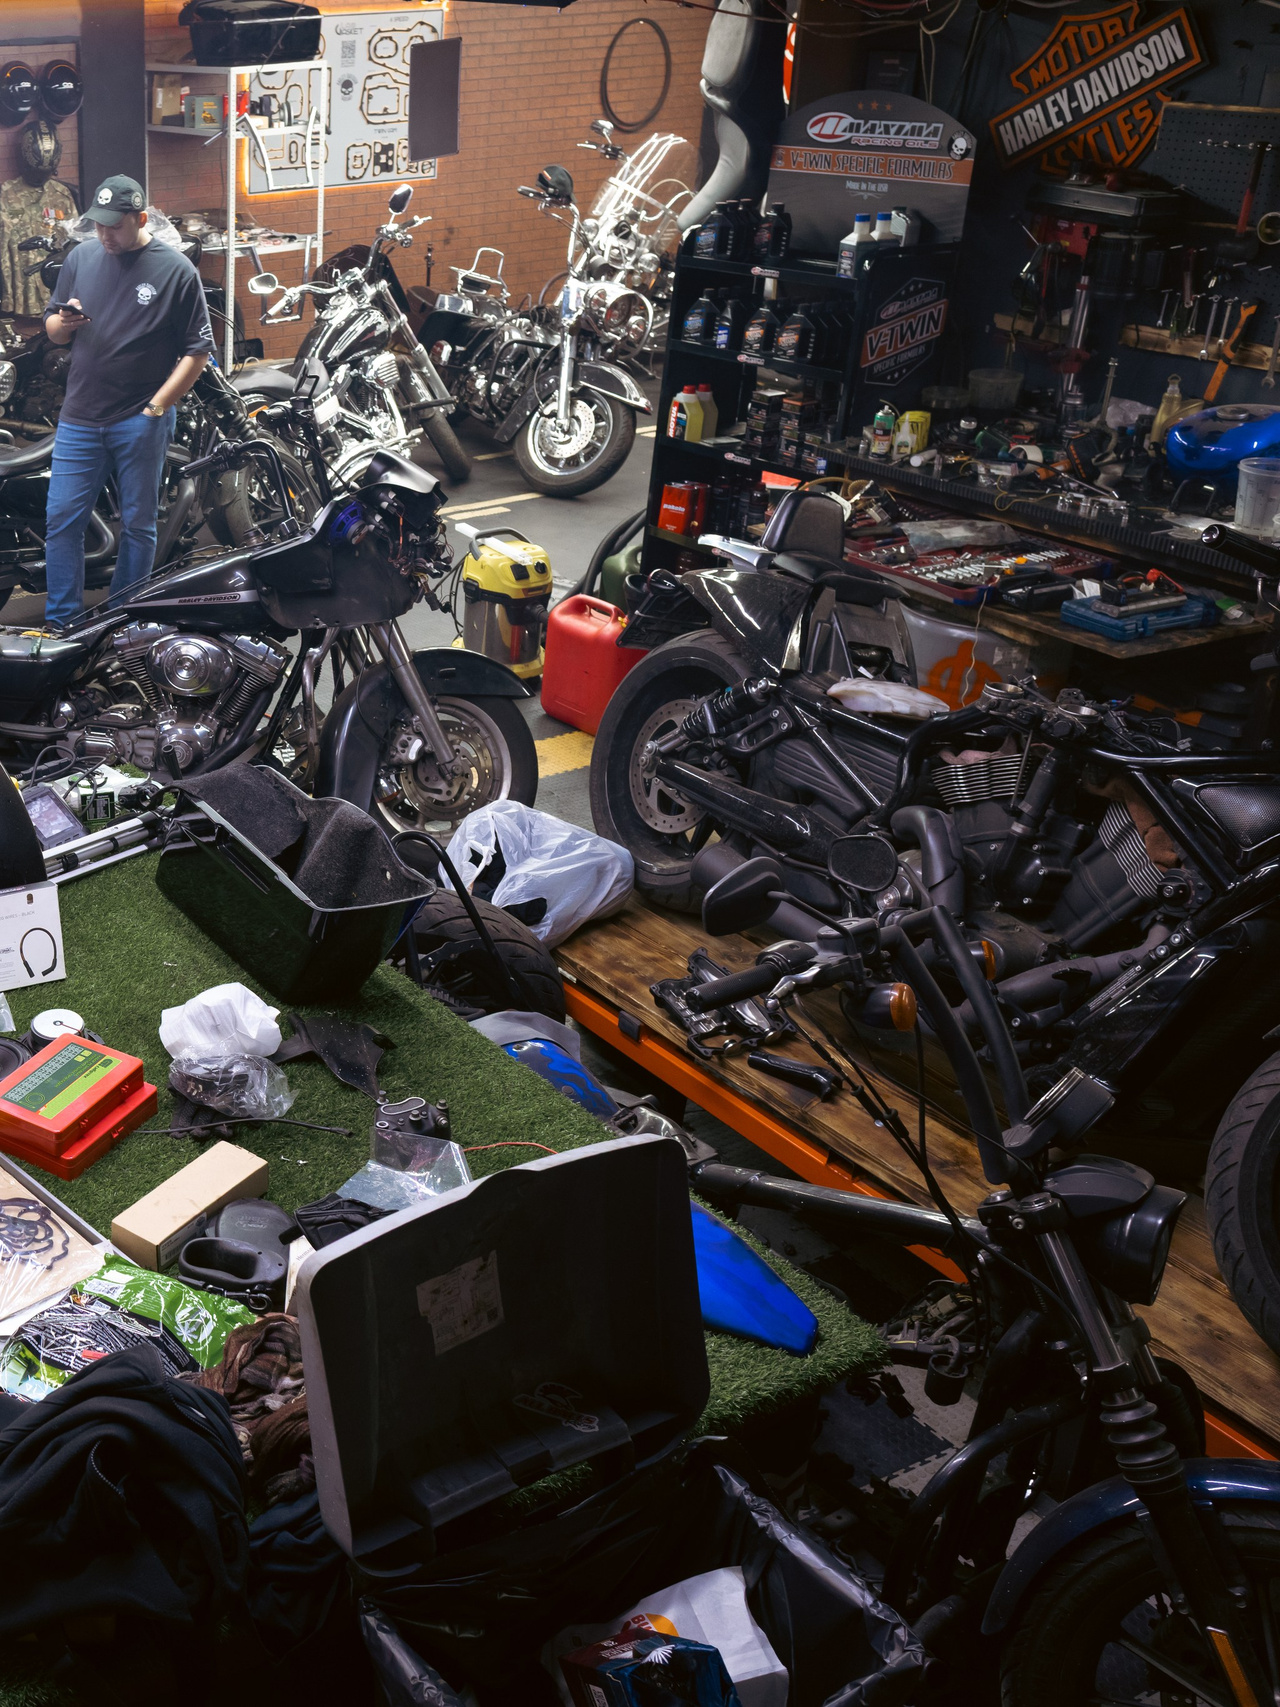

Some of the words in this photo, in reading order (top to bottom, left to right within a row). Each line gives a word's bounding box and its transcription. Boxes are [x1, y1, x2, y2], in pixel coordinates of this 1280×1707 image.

[1028, 16, 1127, 90] MOTOR
[998, 24, 1187, 156] HARLEY-DAVIDSON
[841, 119, 944, 141] MAXIMA
[905, 138, 940, 149] OILS
[1054, 99, 1154, 168] CYCLES
[790, 151, 832, 171] V-TWIN
[835, 154, 885, 175] SPECIFIC
[886, 158, 955, 181] FORMULAS
[867, 304, 945, 361] V-TWIN
[668, 405, 678, 438] MOTUL
[178, 594, 238, 604] HARLEY-DAVIDSON
